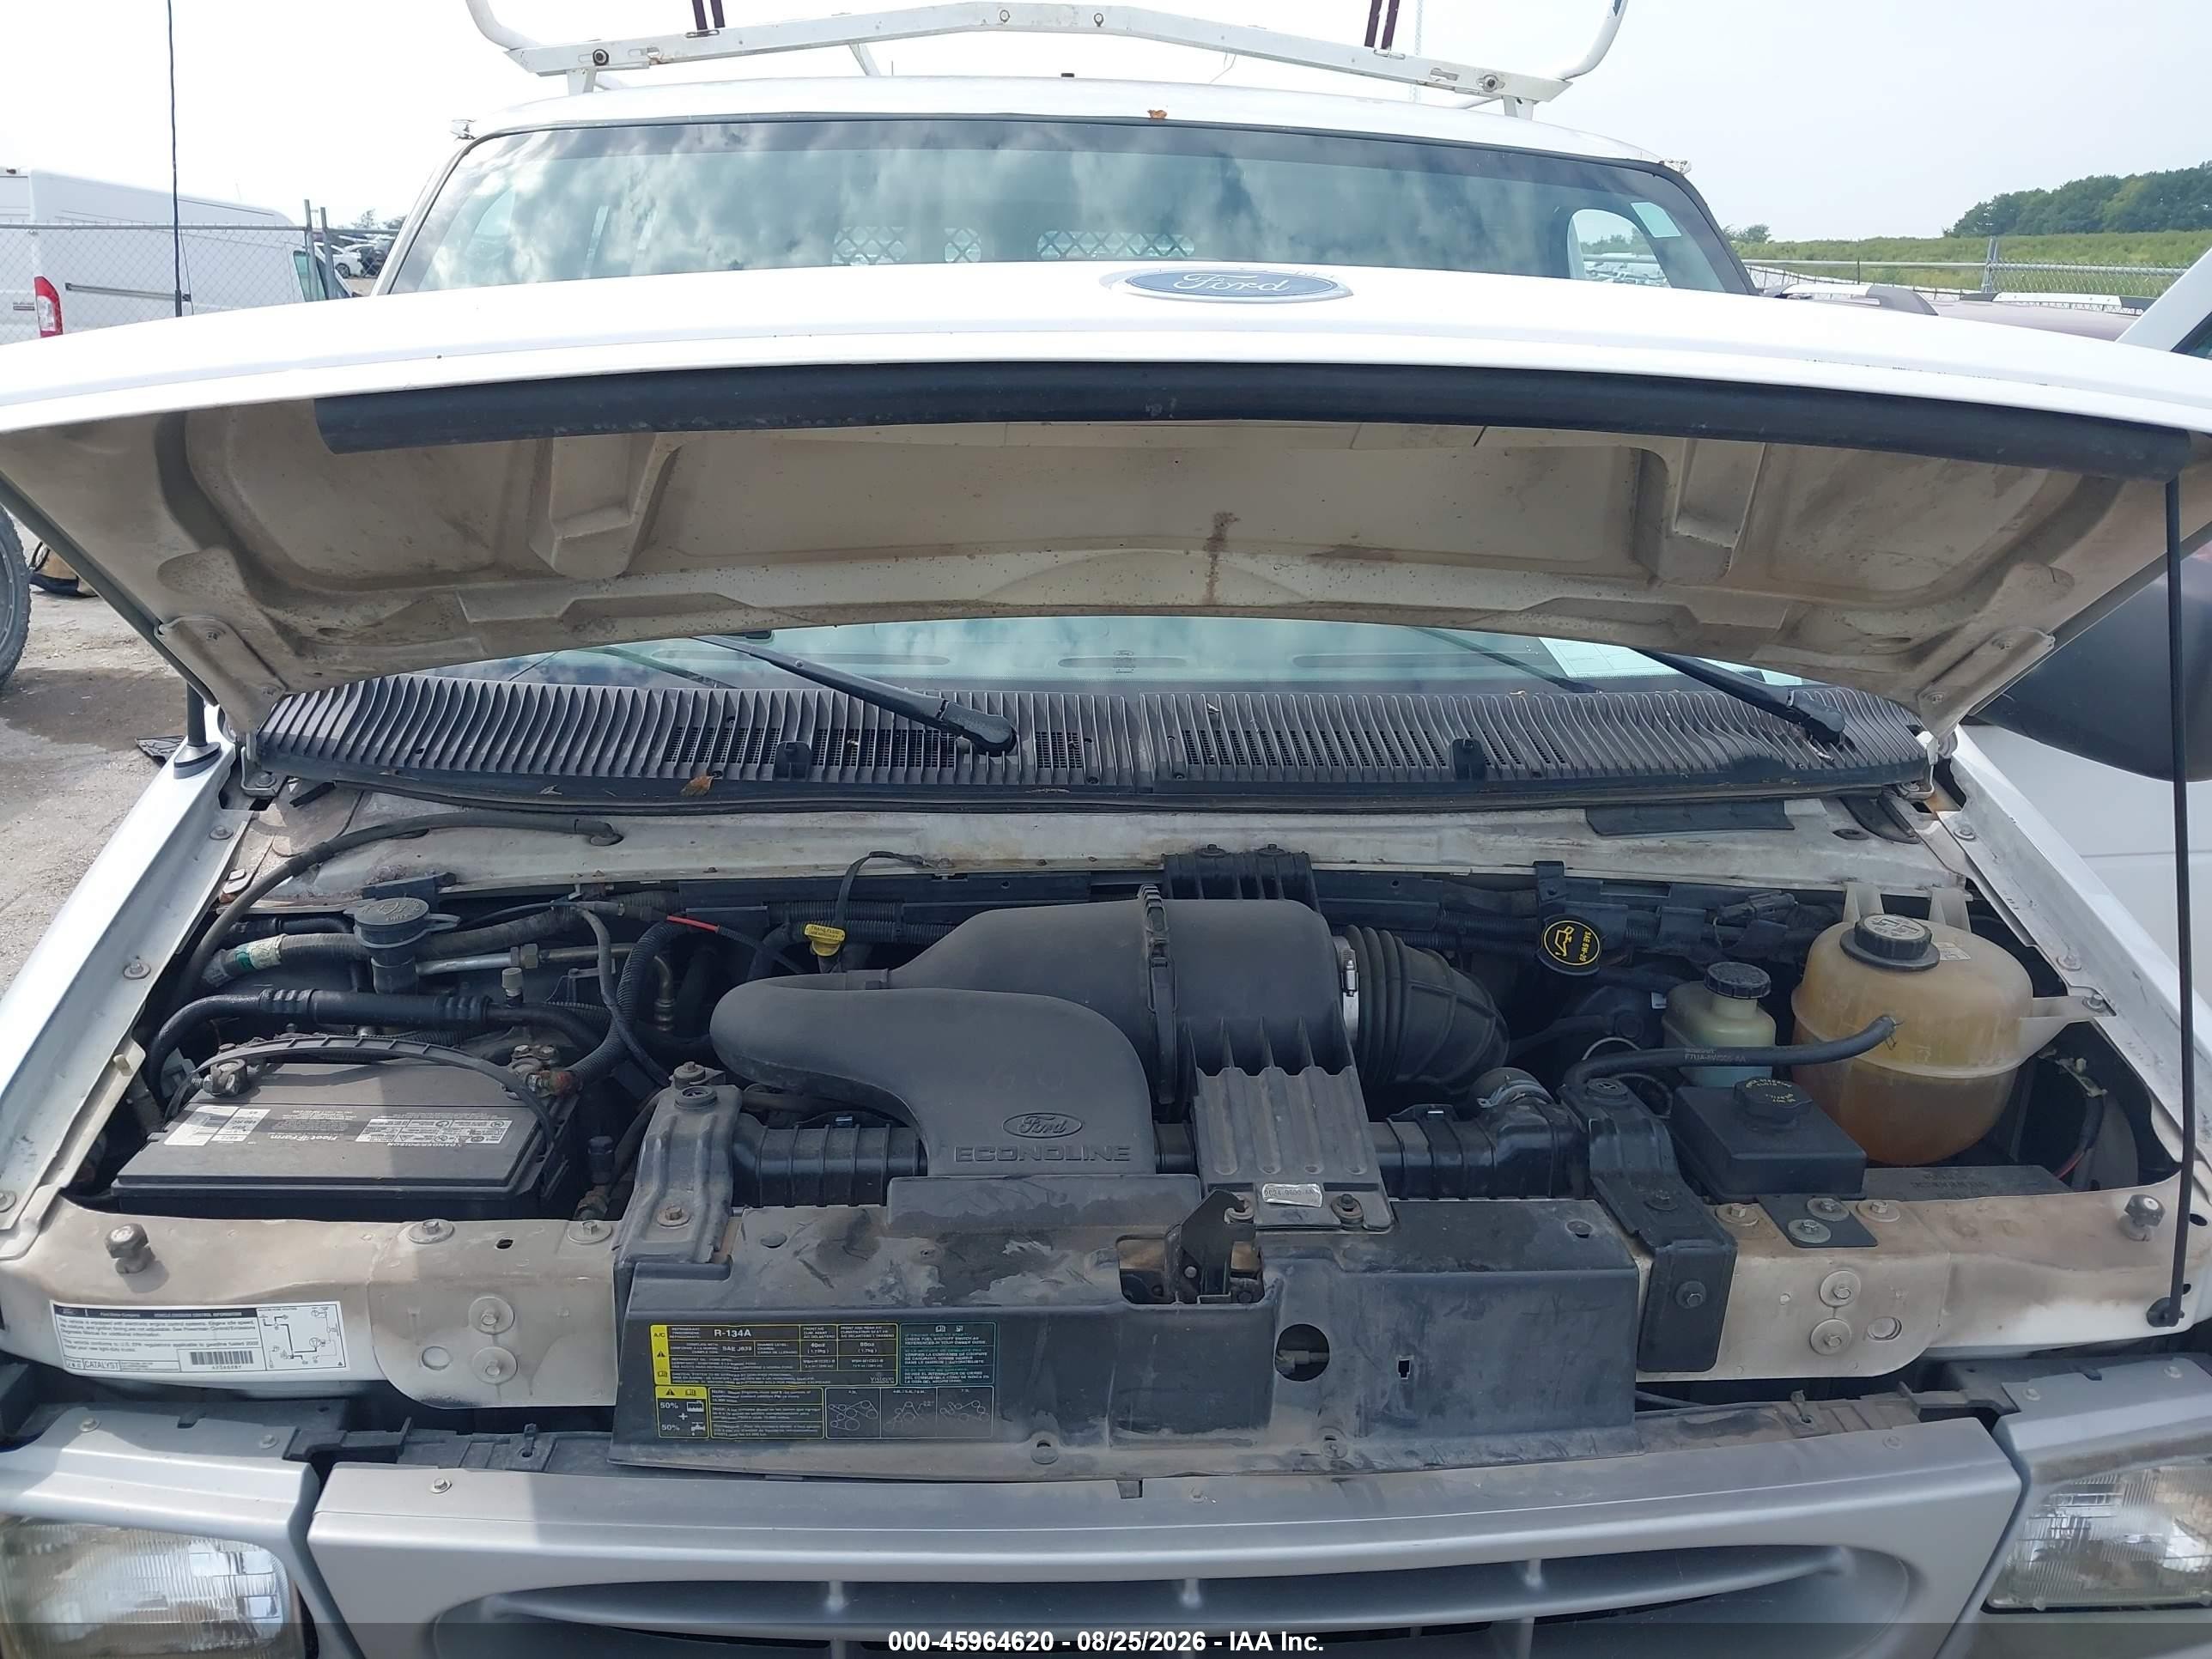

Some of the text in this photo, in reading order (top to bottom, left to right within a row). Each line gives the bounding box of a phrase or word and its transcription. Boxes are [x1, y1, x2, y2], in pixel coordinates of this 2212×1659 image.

[1173, 273, 1291, 291] Ford
[1018, 1115, 1068, 1133] Ford
[954, 1146, 1131, 1162] ECONOLINE
[714, 1329, 752, 1337] R-134A
[85, 1360, 118, 1370] CATALYST
